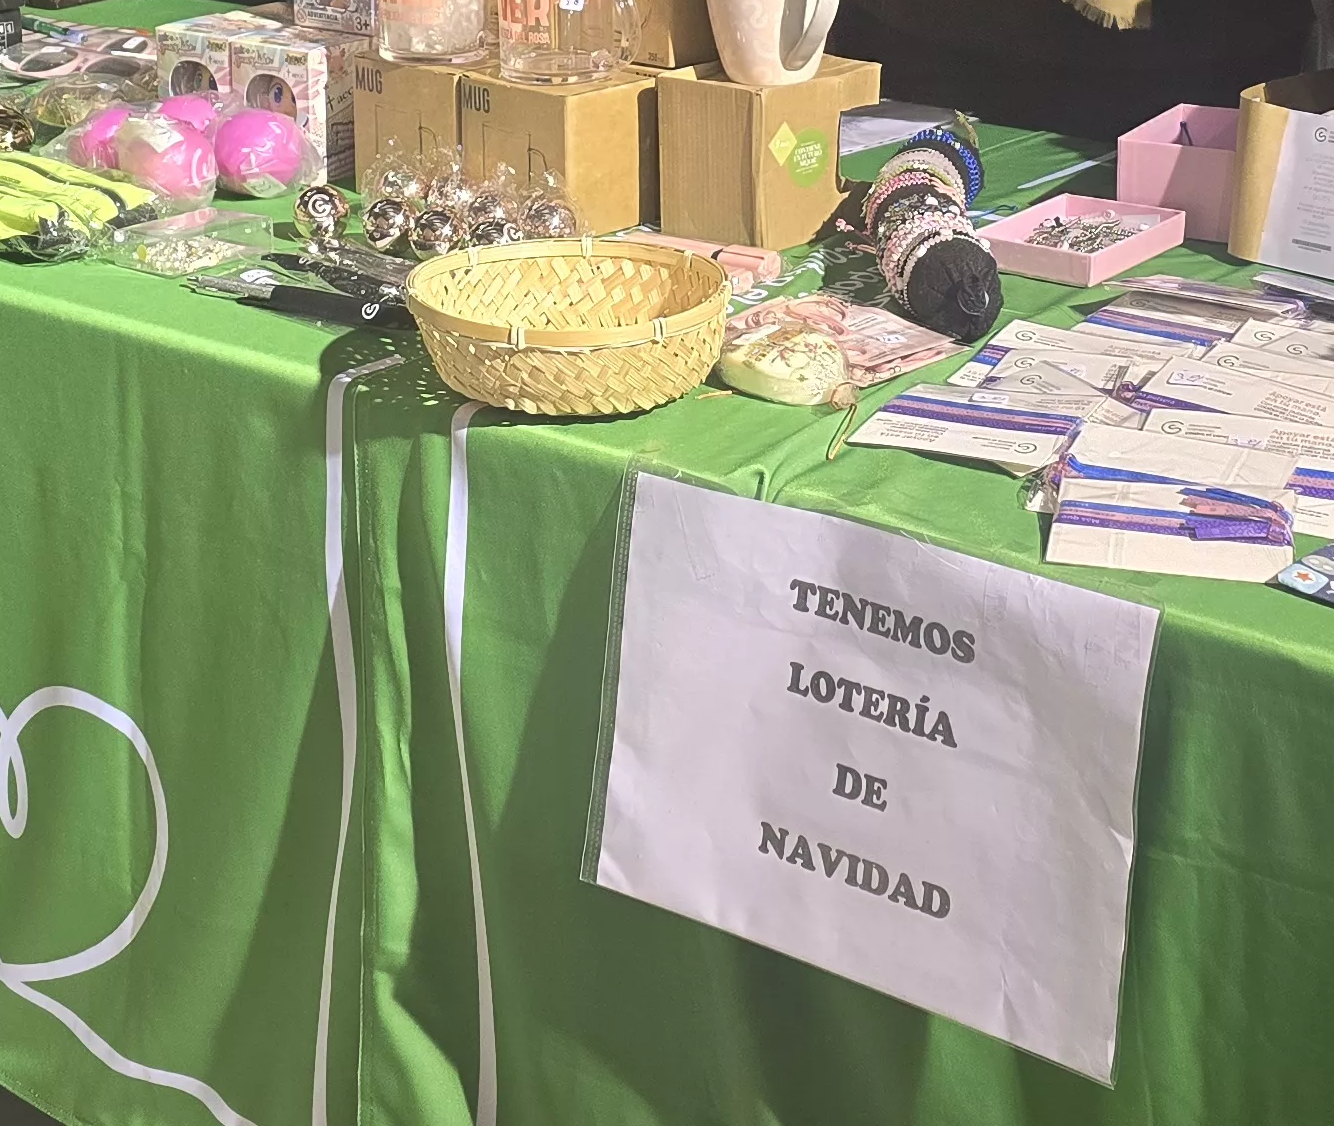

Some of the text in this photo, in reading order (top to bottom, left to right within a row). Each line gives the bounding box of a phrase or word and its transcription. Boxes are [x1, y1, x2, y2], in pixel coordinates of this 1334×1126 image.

[354, 15, 370, 32] 3+
[528, 31, 550, 44] ROSA
[354, 64, 384, 95] MUG
[461, 82, 491, 114] MUG
[1269, 391, 1327, 413] Apoyar está
[1271, 428, 1311, 439] Apoyar
[789, 578, 977, 665] TENEMOS
[786, 661, 958, 749] LOTERÍA
[832, 763, 888, 813] DE
[758, 821, 952, 920] NAVIDAD
